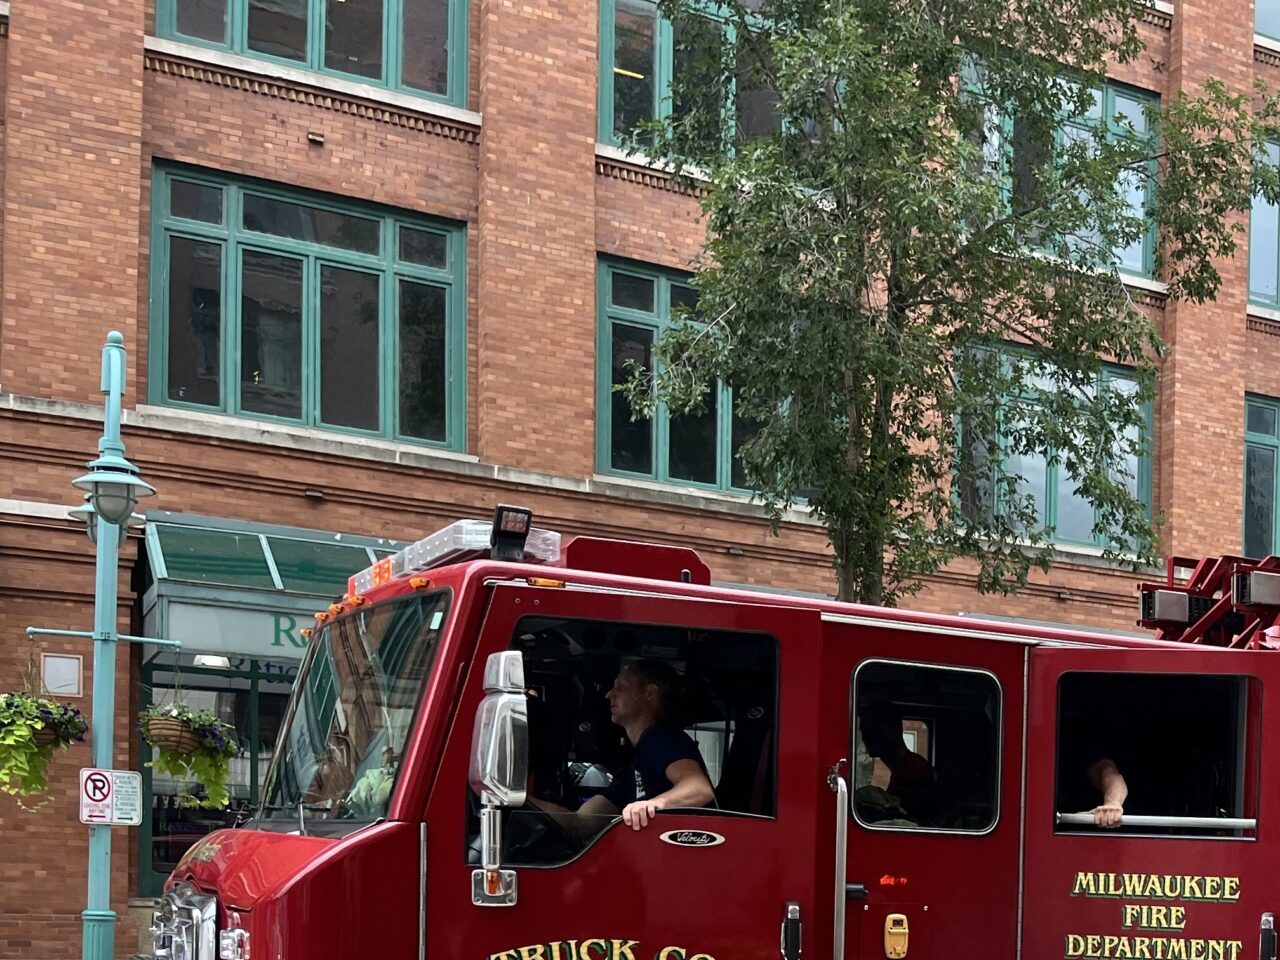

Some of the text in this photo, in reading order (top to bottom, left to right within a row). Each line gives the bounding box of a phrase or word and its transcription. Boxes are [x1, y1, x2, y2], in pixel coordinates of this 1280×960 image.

[676, 831, 711, 844] Velocity
[1072, 872, 1241, 902] MILWAUKEE
[1123, 904, 1187, 930] FIRE
